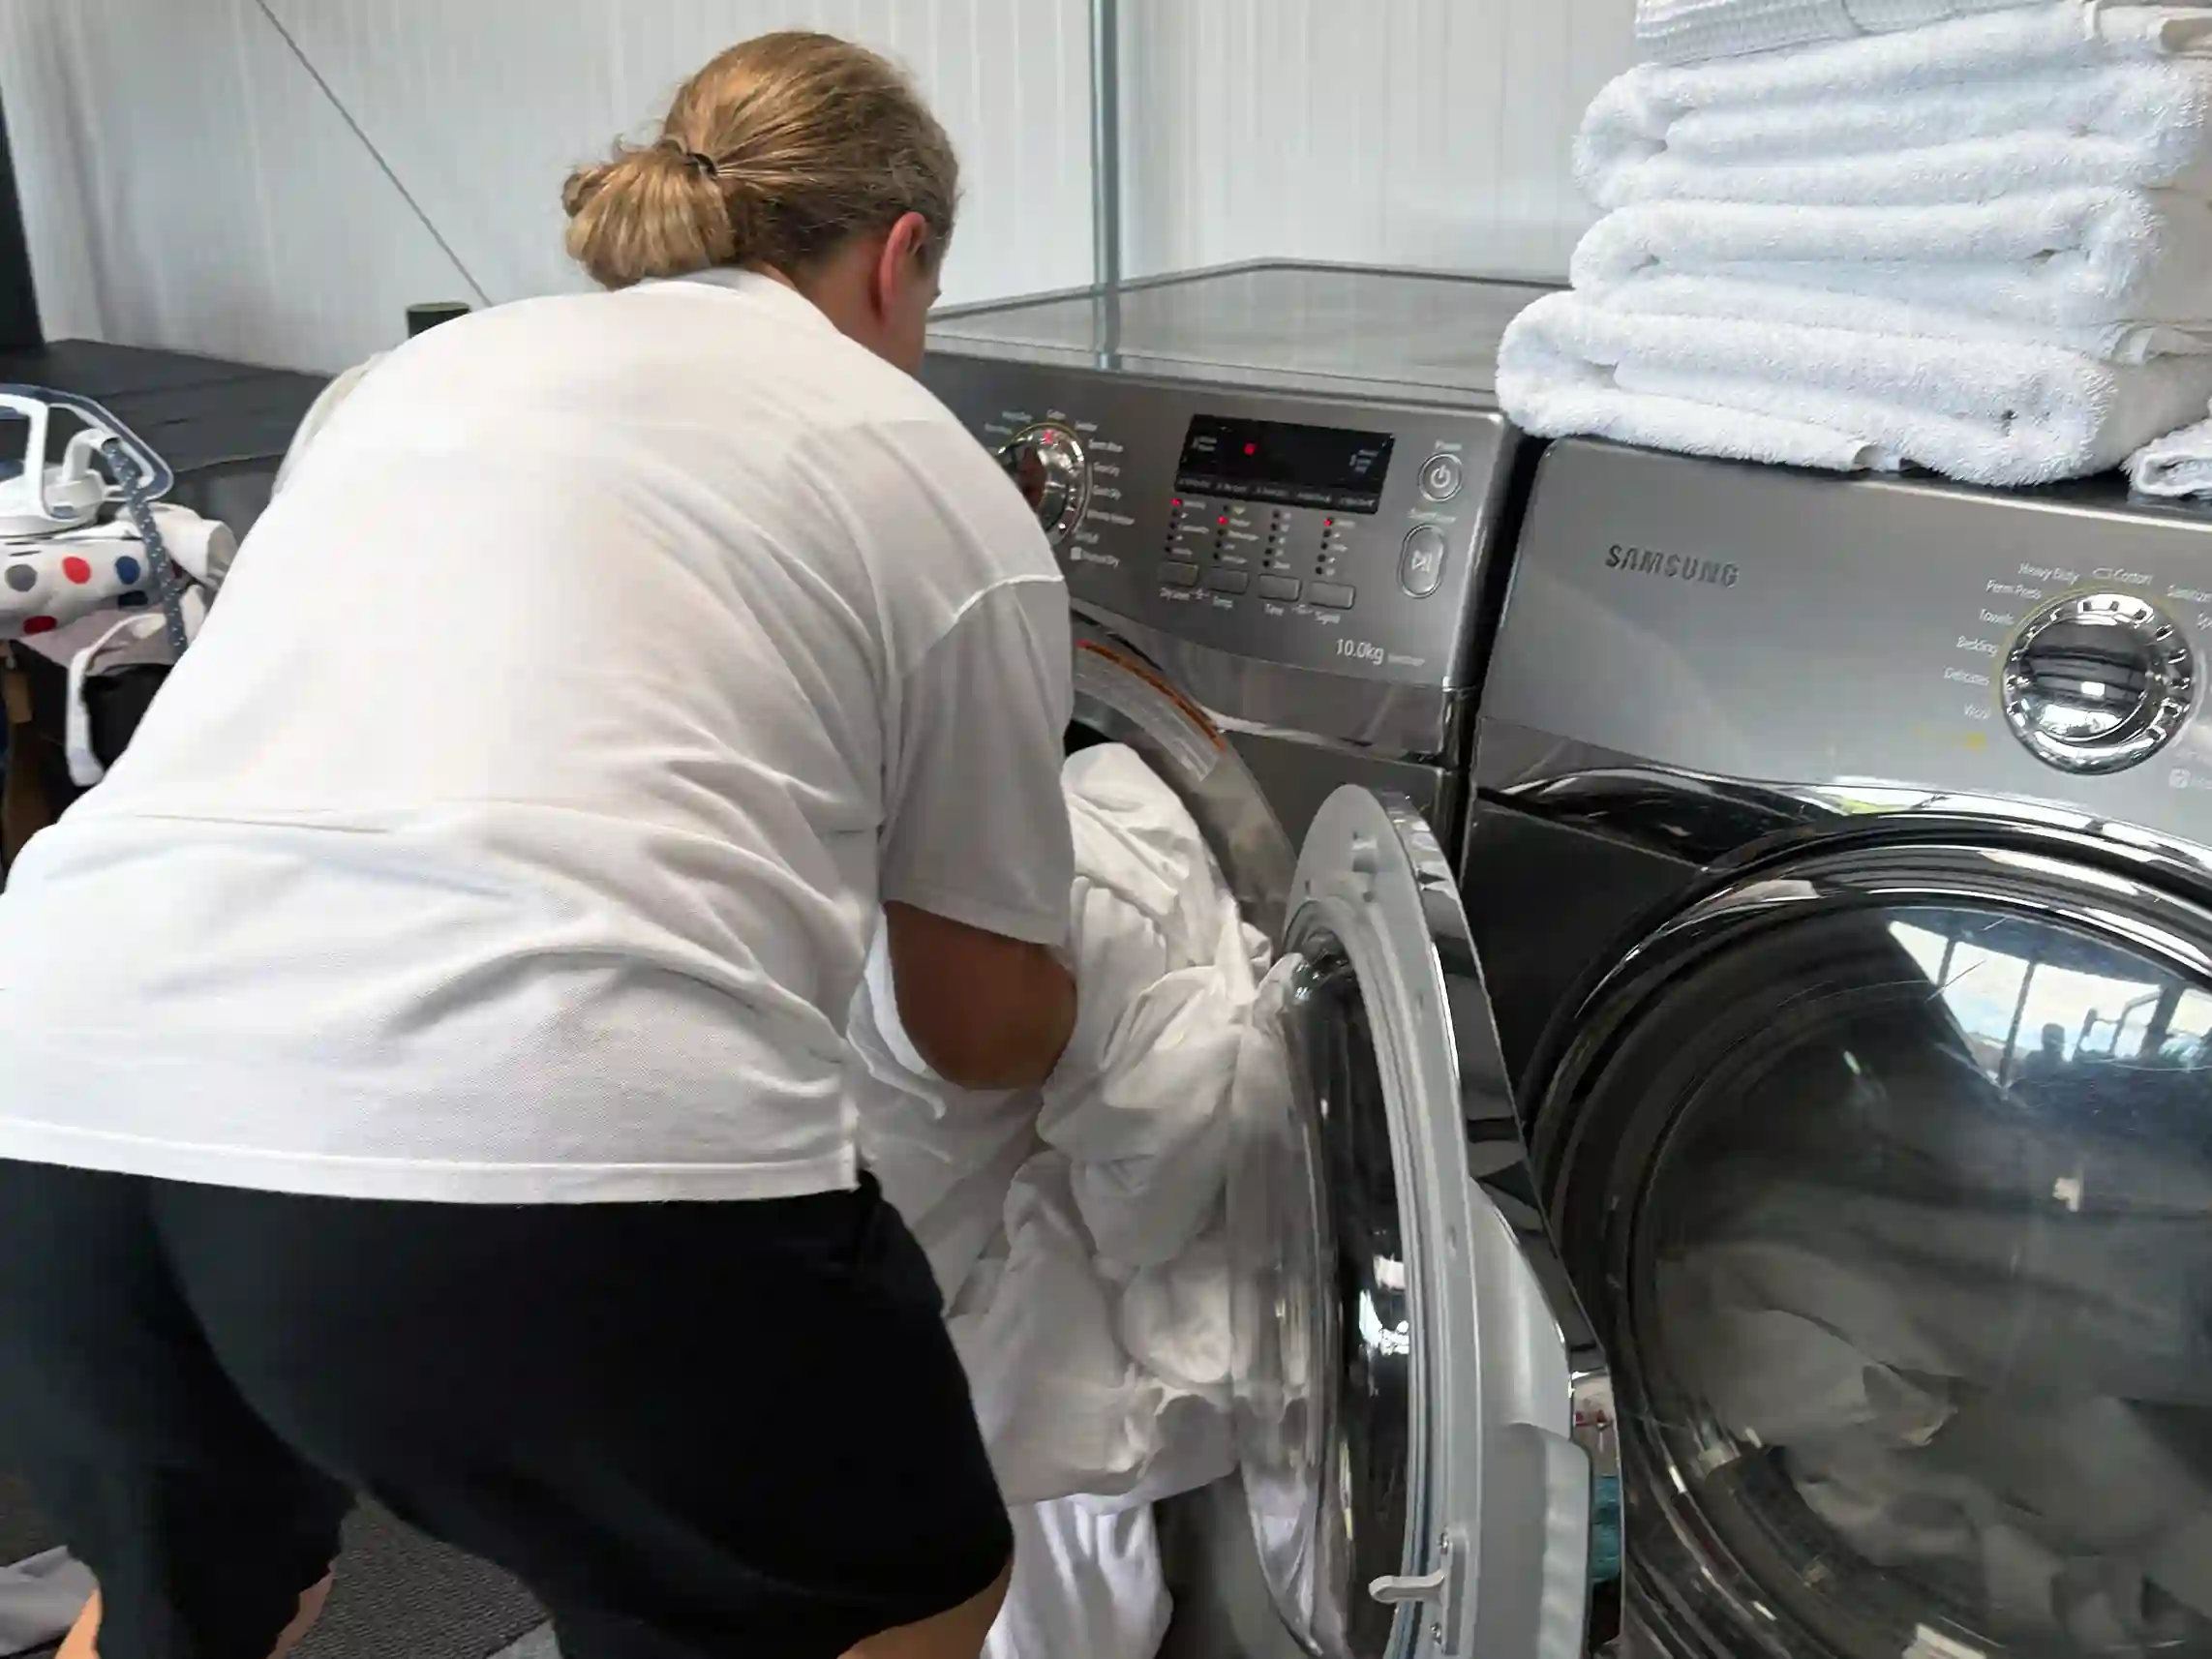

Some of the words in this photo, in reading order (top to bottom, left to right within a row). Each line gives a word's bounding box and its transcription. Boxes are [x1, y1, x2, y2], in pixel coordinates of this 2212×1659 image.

[1605, 543, 1740, 588] SAMSUNG
[1336, 638, 1384, 666] 10.0kg
[1956, 635, 1998, 657] Bedding
